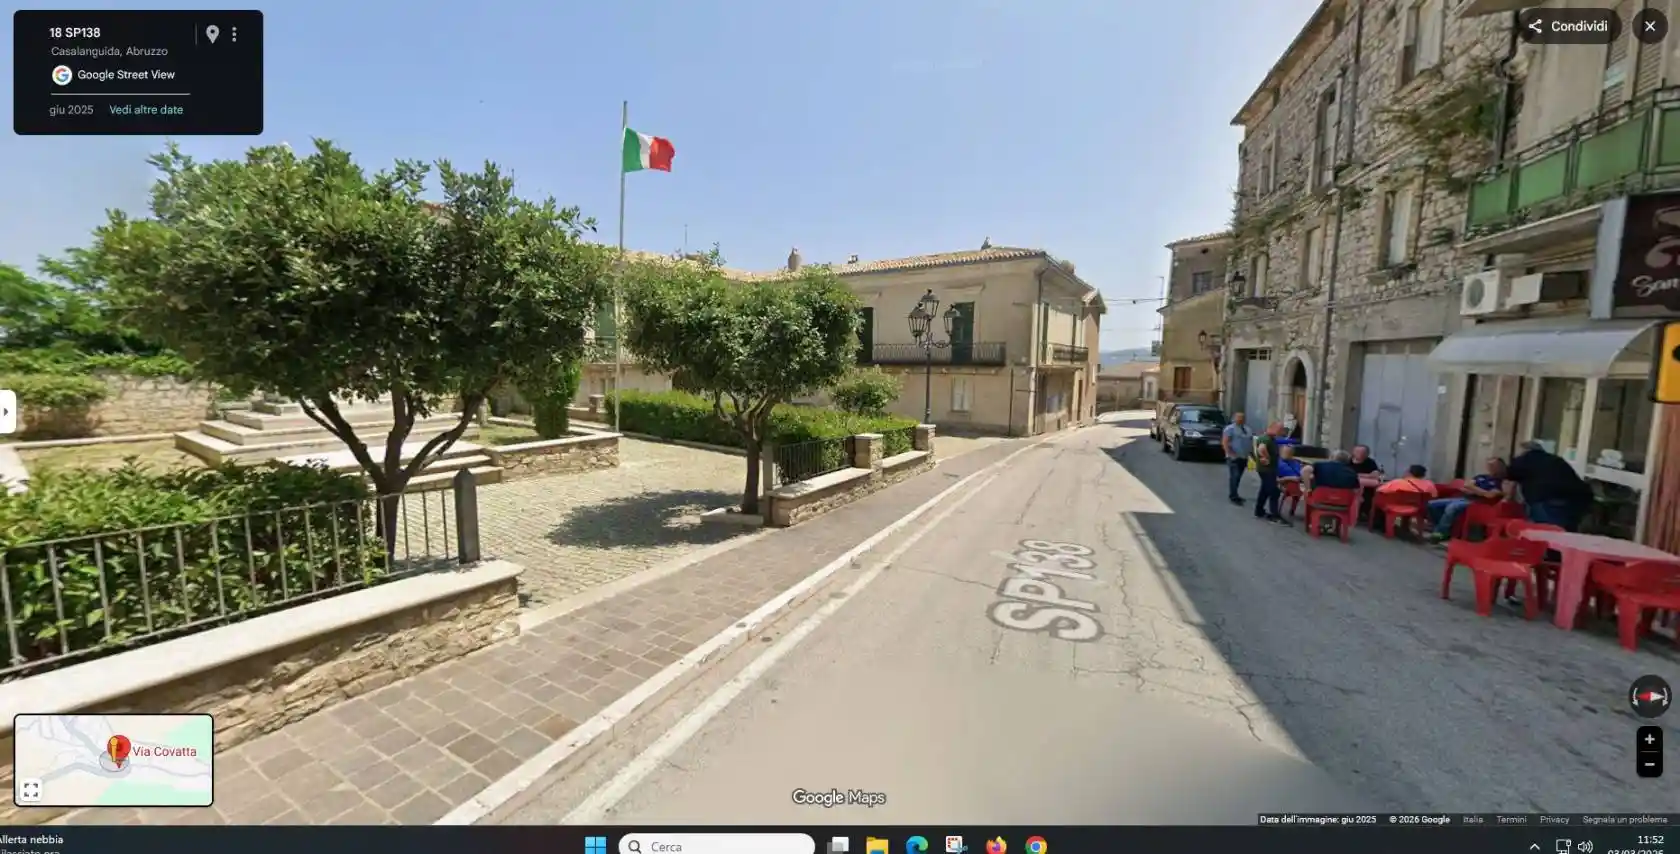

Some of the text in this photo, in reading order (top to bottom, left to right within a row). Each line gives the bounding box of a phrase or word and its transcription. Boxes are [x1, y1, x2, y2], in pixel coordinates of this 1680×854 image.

[30, 834, 64, 844] nebbia
[1638, 835, 1665, 844] 11:52
[651, 841, 682, 852] Cerca
